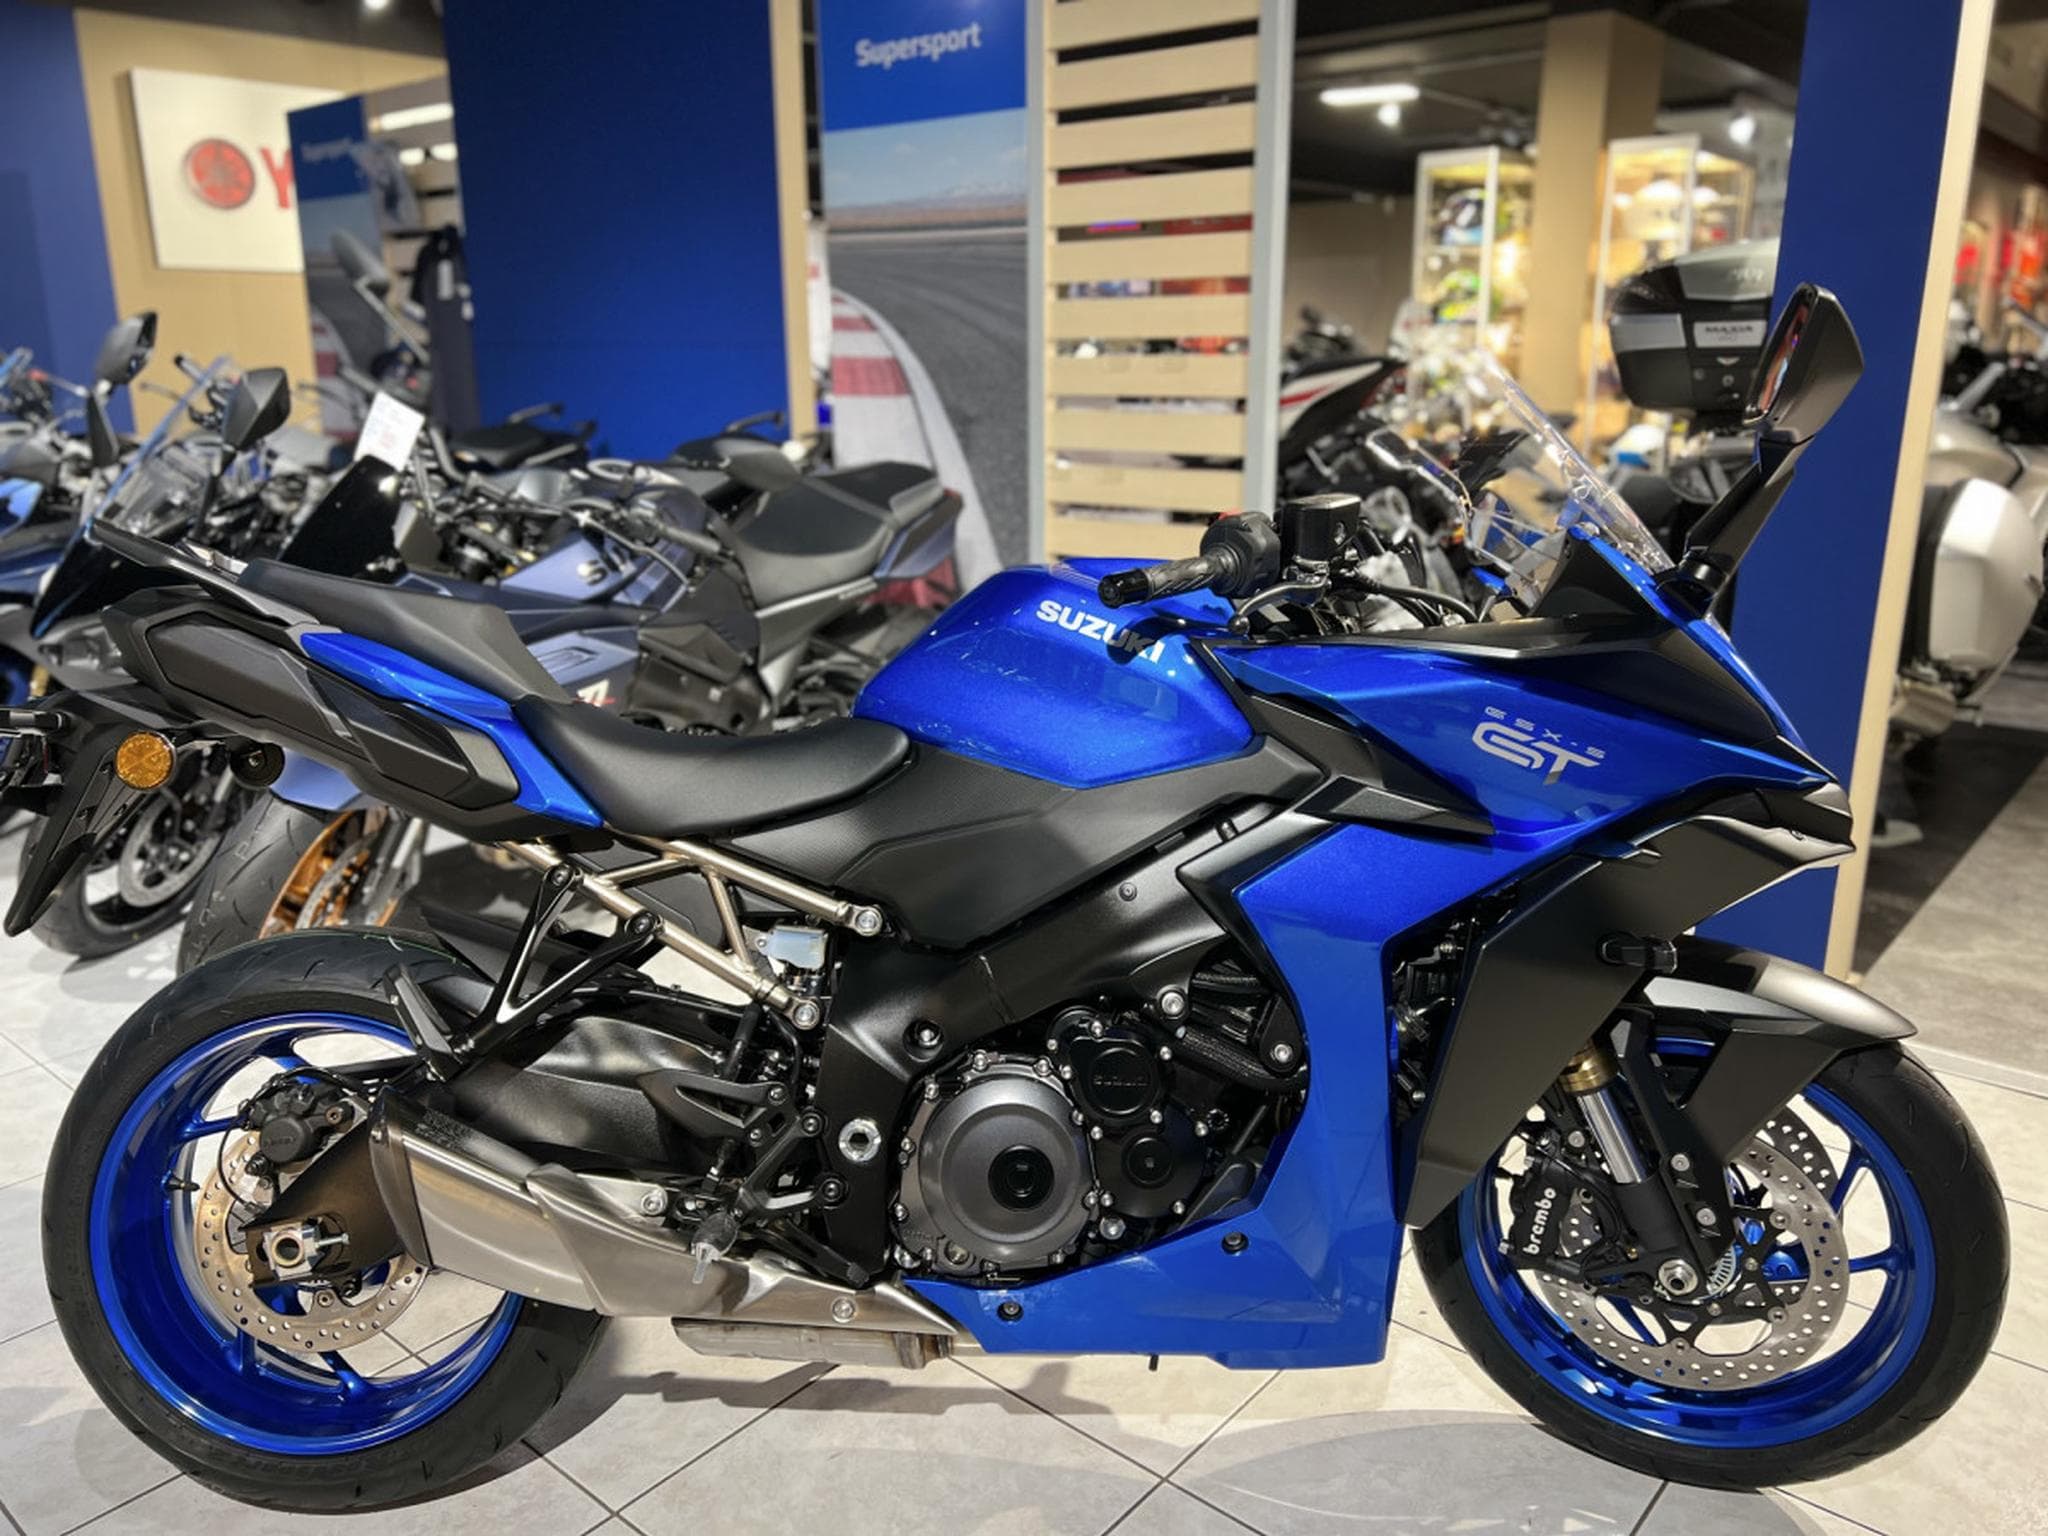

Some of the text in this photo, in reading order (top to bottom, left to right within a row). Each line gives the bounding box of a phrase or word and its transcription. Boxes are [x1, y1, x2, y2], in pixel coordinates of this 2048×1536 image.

[855, 21, 981, 70] Supersport
[1036, 599, 1166, 665] SUZUKI
[1472, 721, 1600, 785] GT
[1523, 1188, 1556, 1255] brembo
